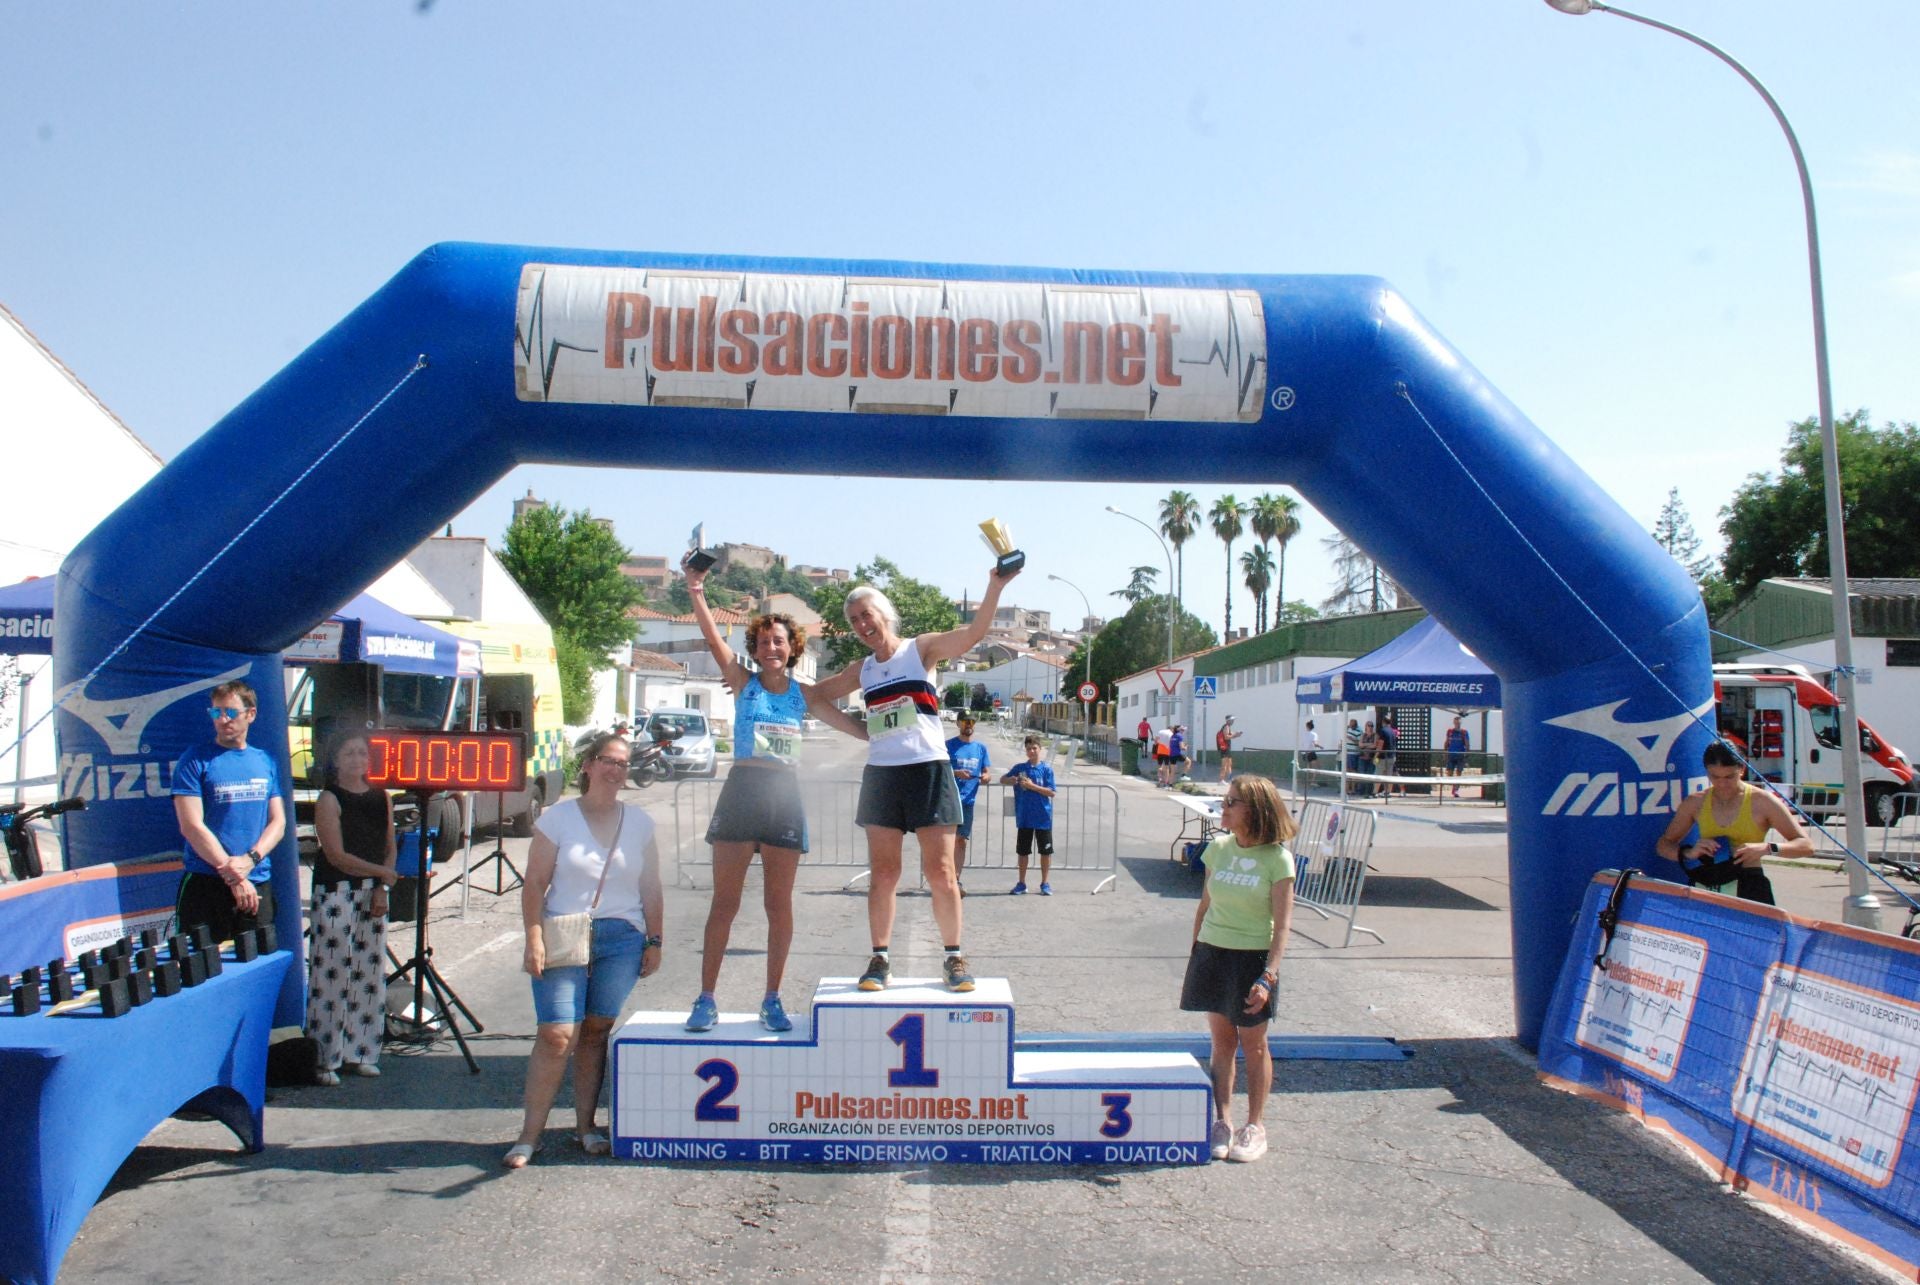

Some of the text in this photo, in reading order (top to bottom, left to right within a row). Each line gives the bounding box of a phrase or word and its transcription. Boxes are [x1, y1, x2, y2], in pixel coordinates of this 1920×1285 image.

[604, 291, 1182, 387] Pulsaciones.net
[1082, 686, 1094, 696] 30
[1354, 681, 1484, 694] WWW.PROTEGEBIKE.ES
[884, 712, 898, 729] 47
[1227, 856, 1238, 870] I
[1215, 871, 1260, 887] GREEN
[1605, 957, 1685, 1001] Pulsaciones.net
[1823, 991, 1833, 1003] DE
[1836, 993, 1870, 1016] EVENTOS
[887, 1013, 938, 1088] 1
[1767, 1010, 1902, 1084] Pulsaciones.net
[694, 1058, 740, 1122] 2
[795, 1092, 1029, 1120] Pulsaciones.net
[1099, 1093, 1133, 1139] 3
[768, 1121, 1055, 1136] ORGANIZACIÓN DE EVENTOS DEPORTIVOS
[632, 1142, 727, 1160] RUNNING
[759, 1144, 791, 1161] BTT
[823, 1144, 948, 1162] SENDERISMO
[981, 1142, 1071, 1162] TRIATLÓN
[1105, 1142, 1198, 1163] DUATLÓN
